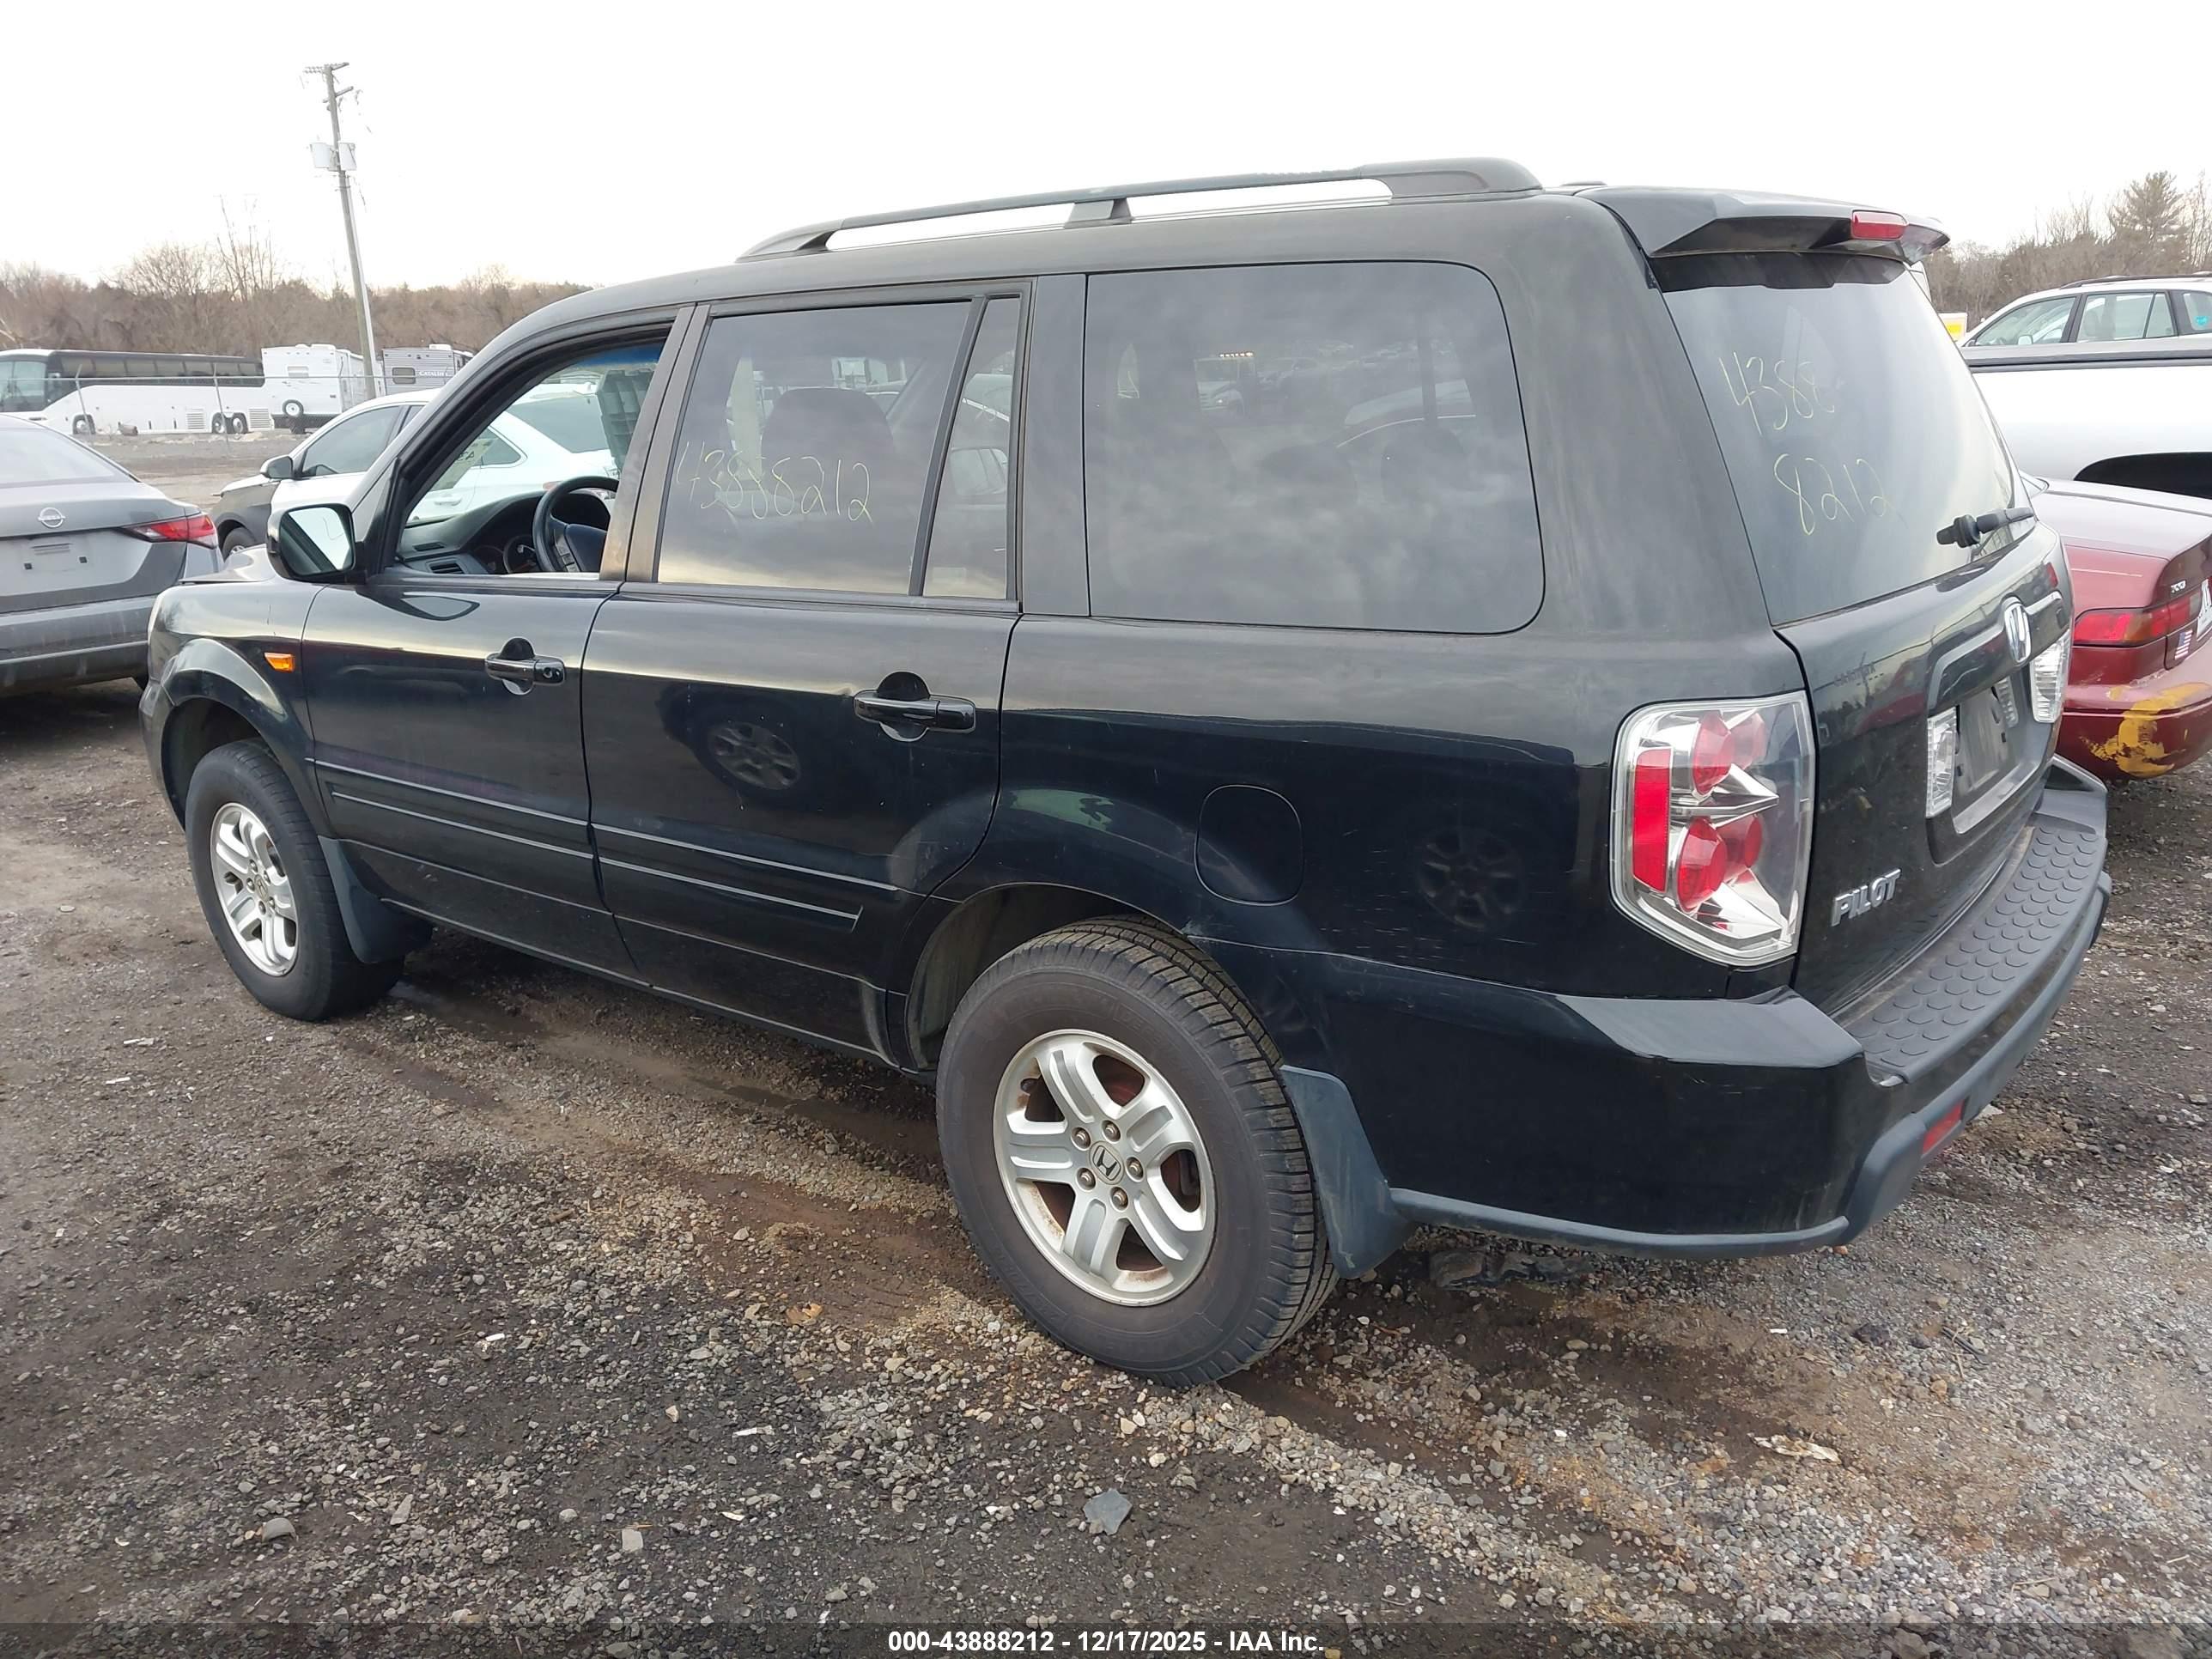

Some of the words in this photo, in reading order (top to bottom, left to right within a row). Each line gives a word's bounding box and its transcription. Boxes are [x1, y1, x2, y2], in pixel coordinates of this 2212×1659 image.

[677, 441, 874, 524] 43888212
[1773, 453, 1894, 536] 8212
[1831, 868, 1901, 927] PILOT
